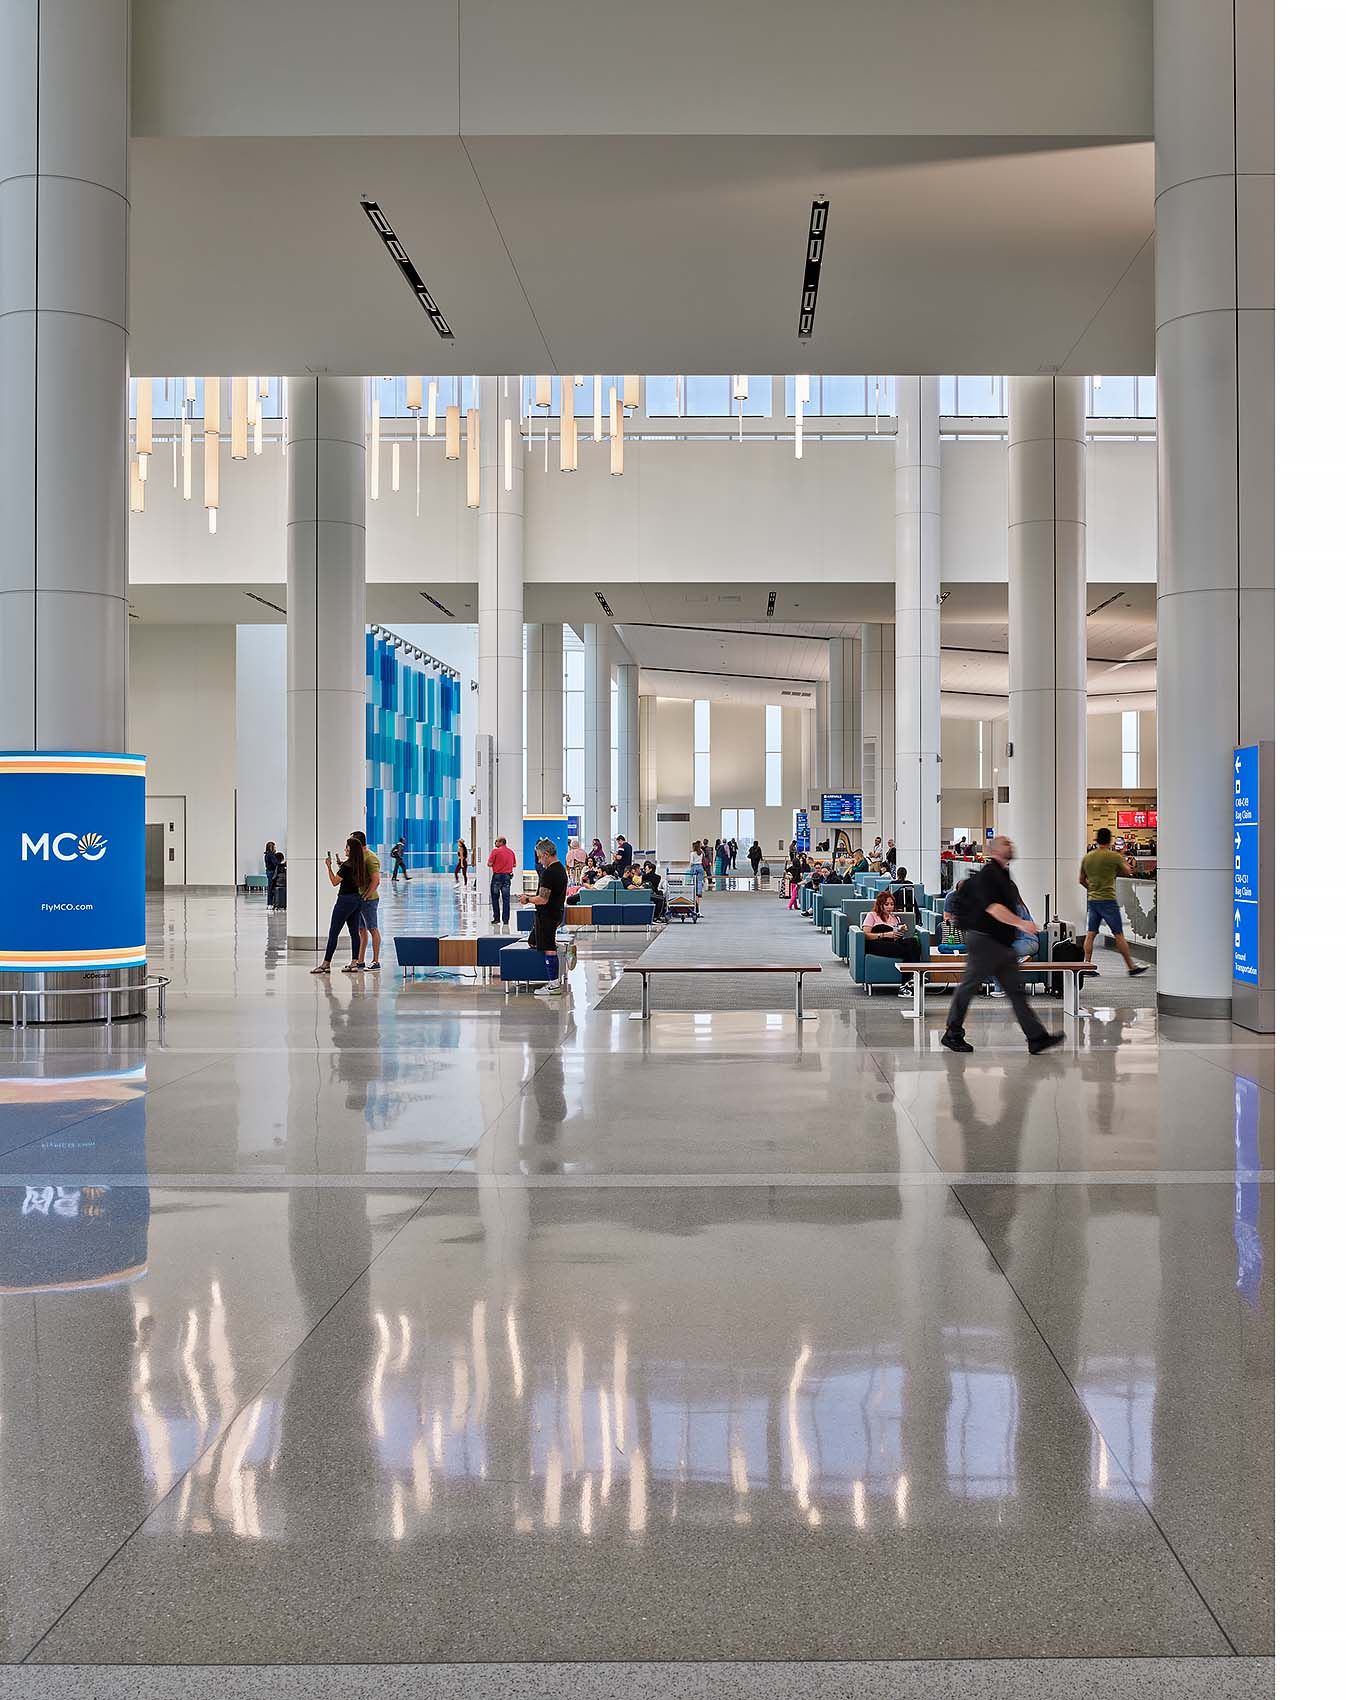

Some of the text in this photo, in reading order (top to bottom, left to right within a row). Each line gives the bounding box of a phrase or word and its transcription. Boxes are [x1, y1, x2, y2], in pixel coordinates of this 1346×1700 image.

[21, 832, 109, 862] MCO
[41, 903, 94, 913] FlyMCO.com
[1234, 951, 1247, 961] Ground
[1234, 962, 1258, 976] Transportation
